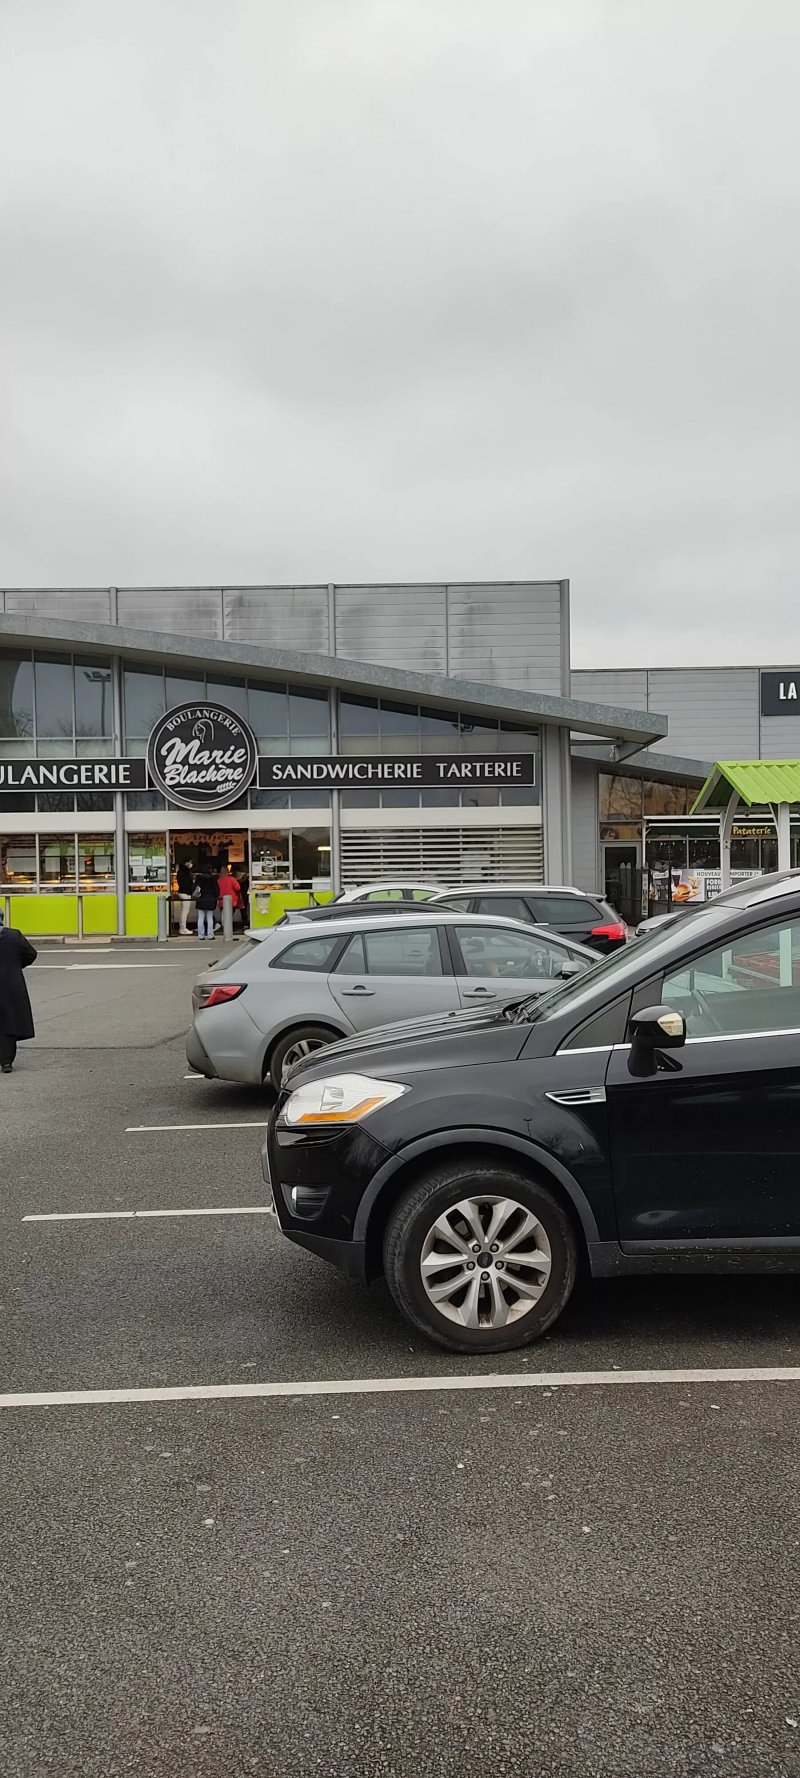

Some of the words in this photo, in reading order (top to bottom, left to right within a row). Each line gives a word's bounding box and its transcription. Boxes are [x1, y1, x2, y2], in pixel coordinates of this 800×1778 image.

[779, 682, 798, 700] LA
[166, 709, 241, 736] BOULANGERIE
[160, 737, 247, 766] Marie
[163, 763, 244, 786] Blachère
[272, 763, 422, 780] SANDWICHERIE
[435, 762, 522, 778] TARTERIE
[732, 825, 772, 835] Pataterie
